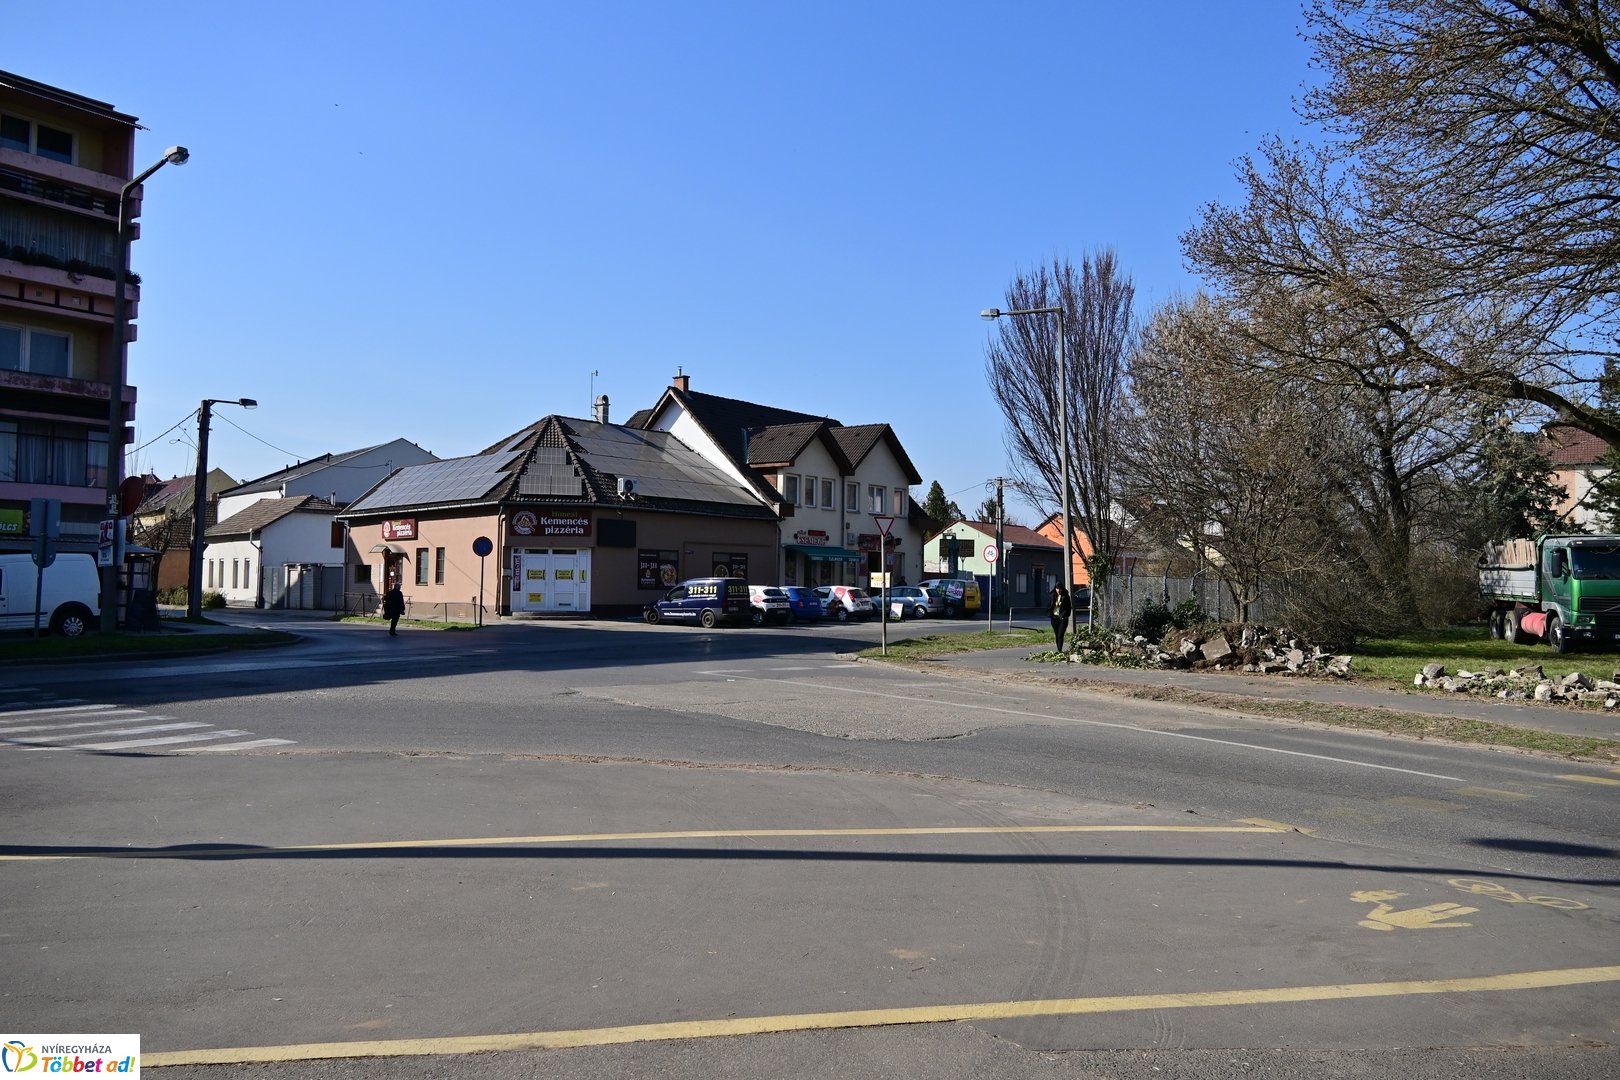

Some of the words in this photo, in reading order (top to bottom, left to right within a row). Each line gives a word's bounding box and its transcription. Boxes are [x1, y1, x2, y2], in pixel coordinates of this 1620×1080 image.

[540, 516, 589, 526] Kemencés
[545, 526, 584, 535] pizzéria
[688, 586, 717, 595] 311-311
[727, 585, 748, 593] 311-311
